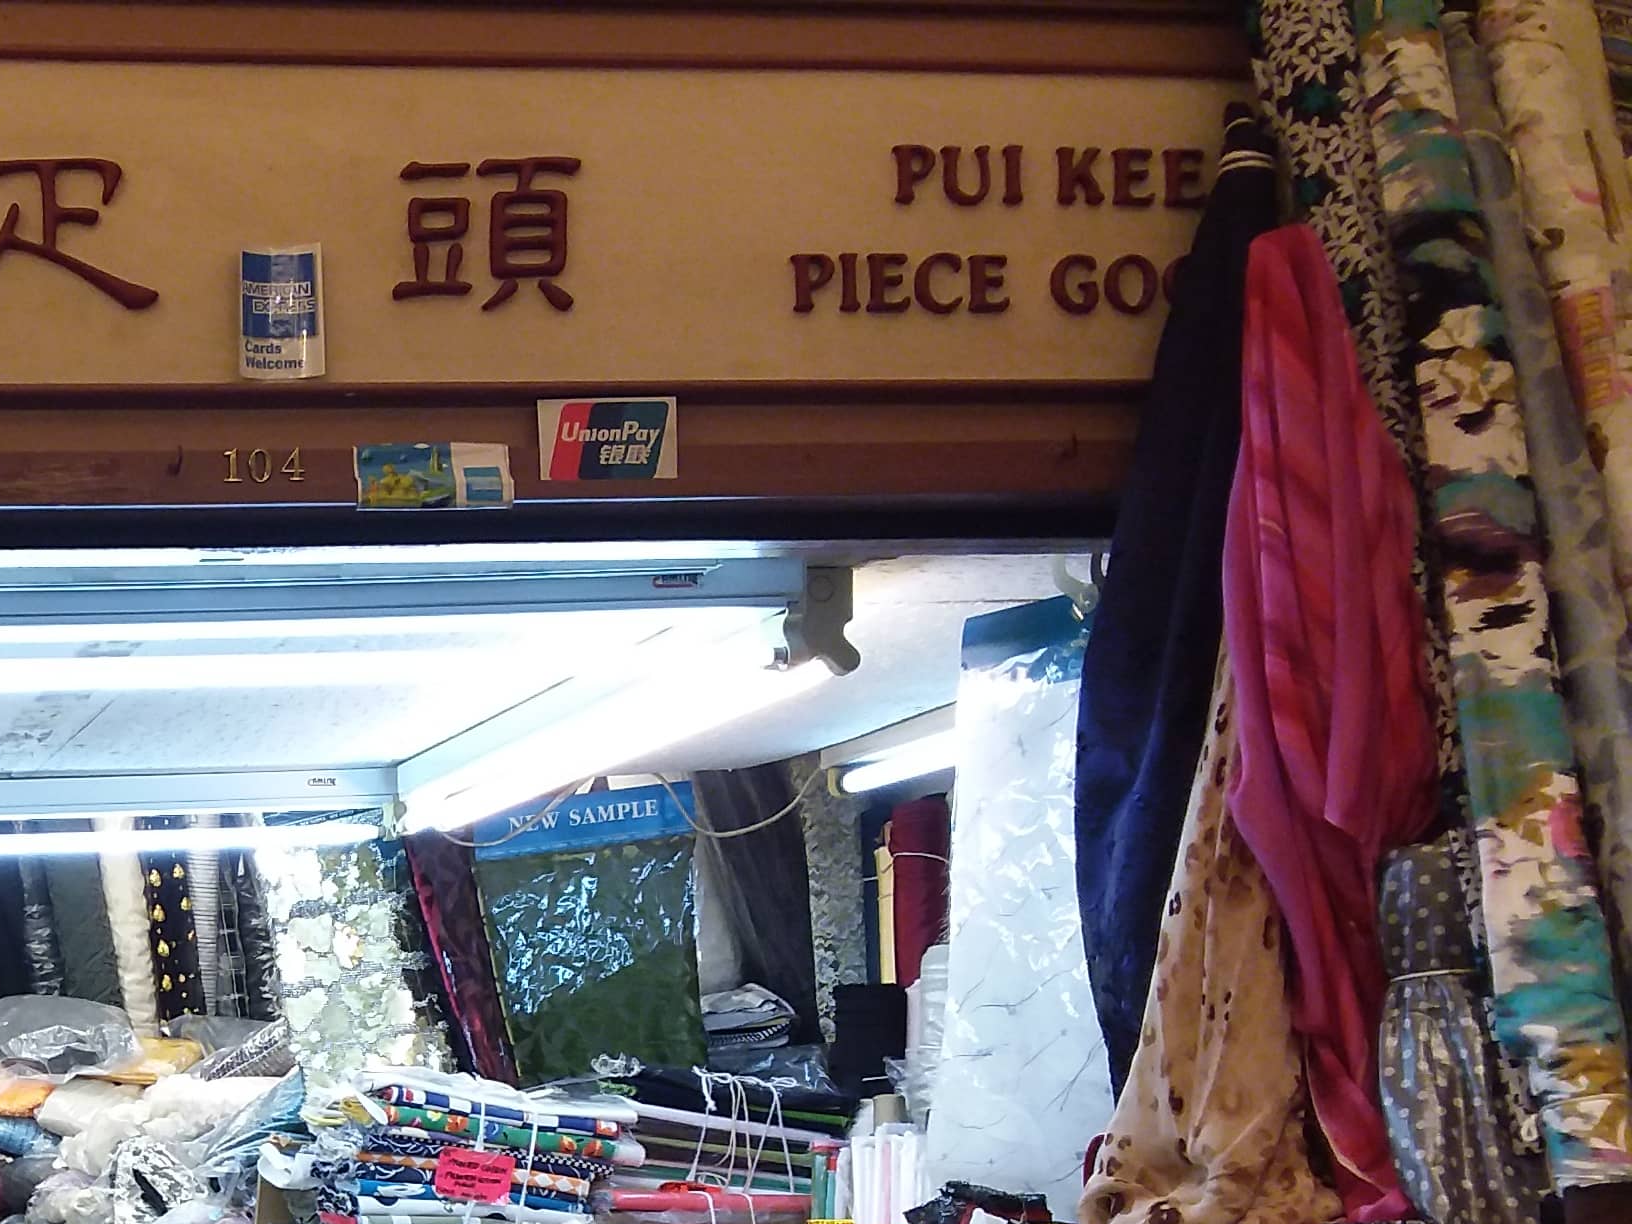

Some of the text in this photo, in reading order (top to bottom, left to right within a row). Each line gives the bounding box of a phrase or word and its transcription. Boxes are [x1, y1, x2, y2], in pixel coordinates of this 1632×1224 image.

[892, 145, 1206, 208] PUI KEE
[790, 252, 1010, 314] PIECE
[245, 341, 282, 354] Cards
[245, 357, 305, 369] Welcome
[561, 420, 660, 448] UnionPay
[223, 447, 306, 483] 104
[508, 799, 659, 833] NEW SAMPLE
